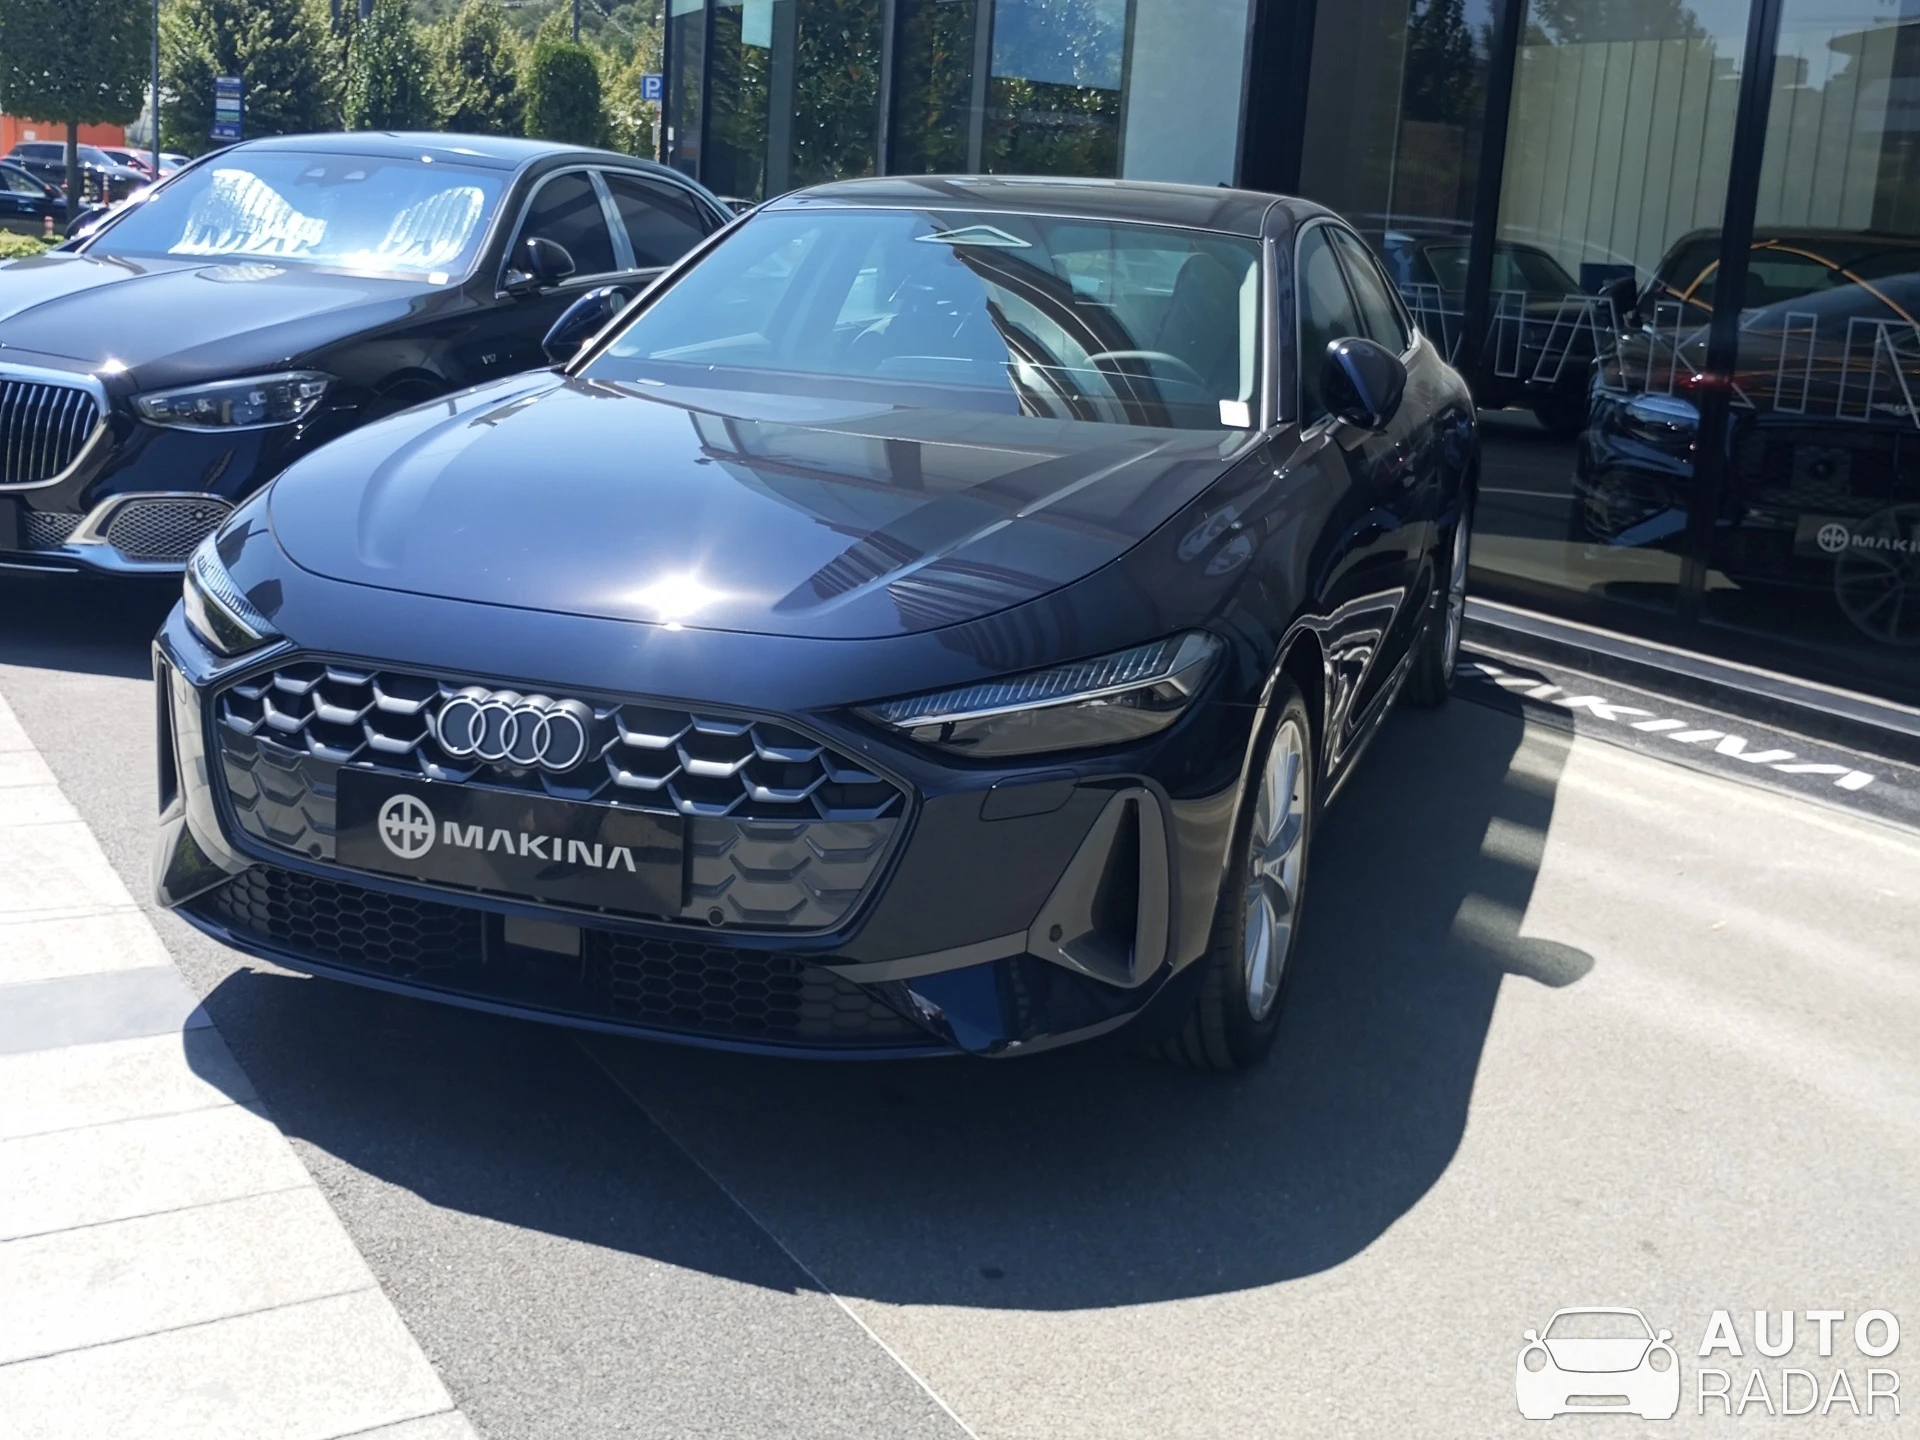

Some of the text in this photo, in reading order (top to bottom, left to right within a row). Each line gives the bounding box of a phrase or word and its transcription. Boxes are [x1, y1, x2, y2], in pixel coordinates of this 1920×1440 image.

[645, 77, 661, 98] P
[1852, 534, 1920, 553] MAKI
[443, 820, 637, 873] MAKINA
